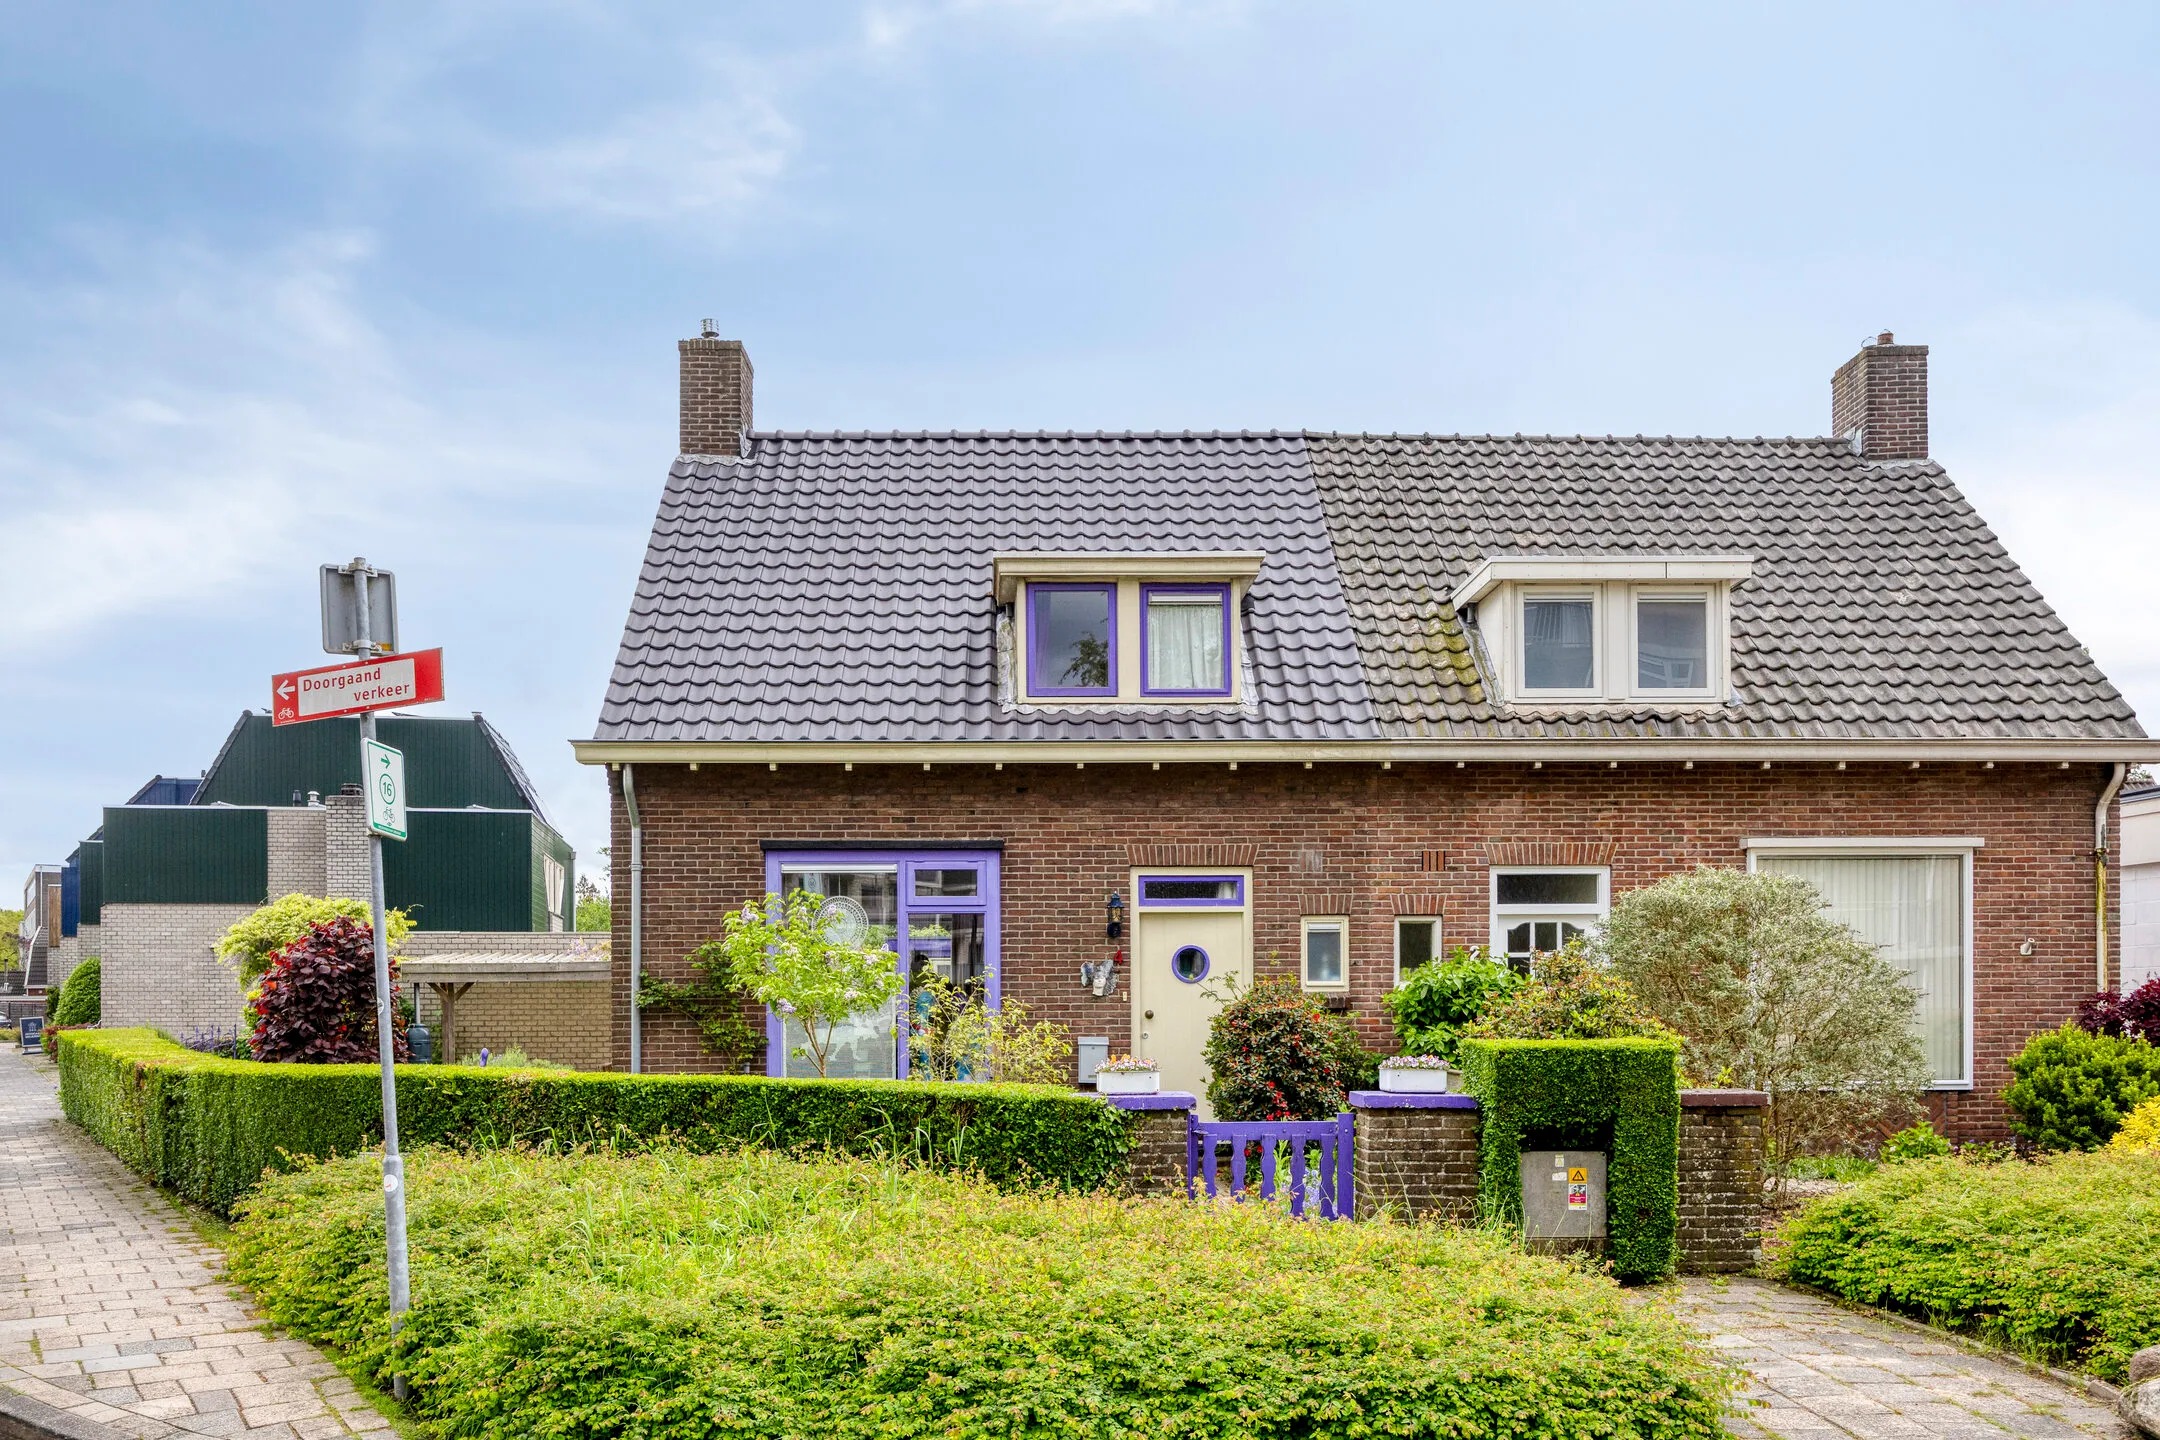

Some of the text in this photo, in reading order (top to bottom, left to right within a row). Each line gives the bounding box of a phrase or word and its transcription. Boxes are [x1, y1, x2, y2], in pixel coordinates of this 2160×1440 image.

[303, 668, 381, 691] Doorgaand
[354, 684, 410, 701] verkeer
[383, 782, 392, 797] 16
